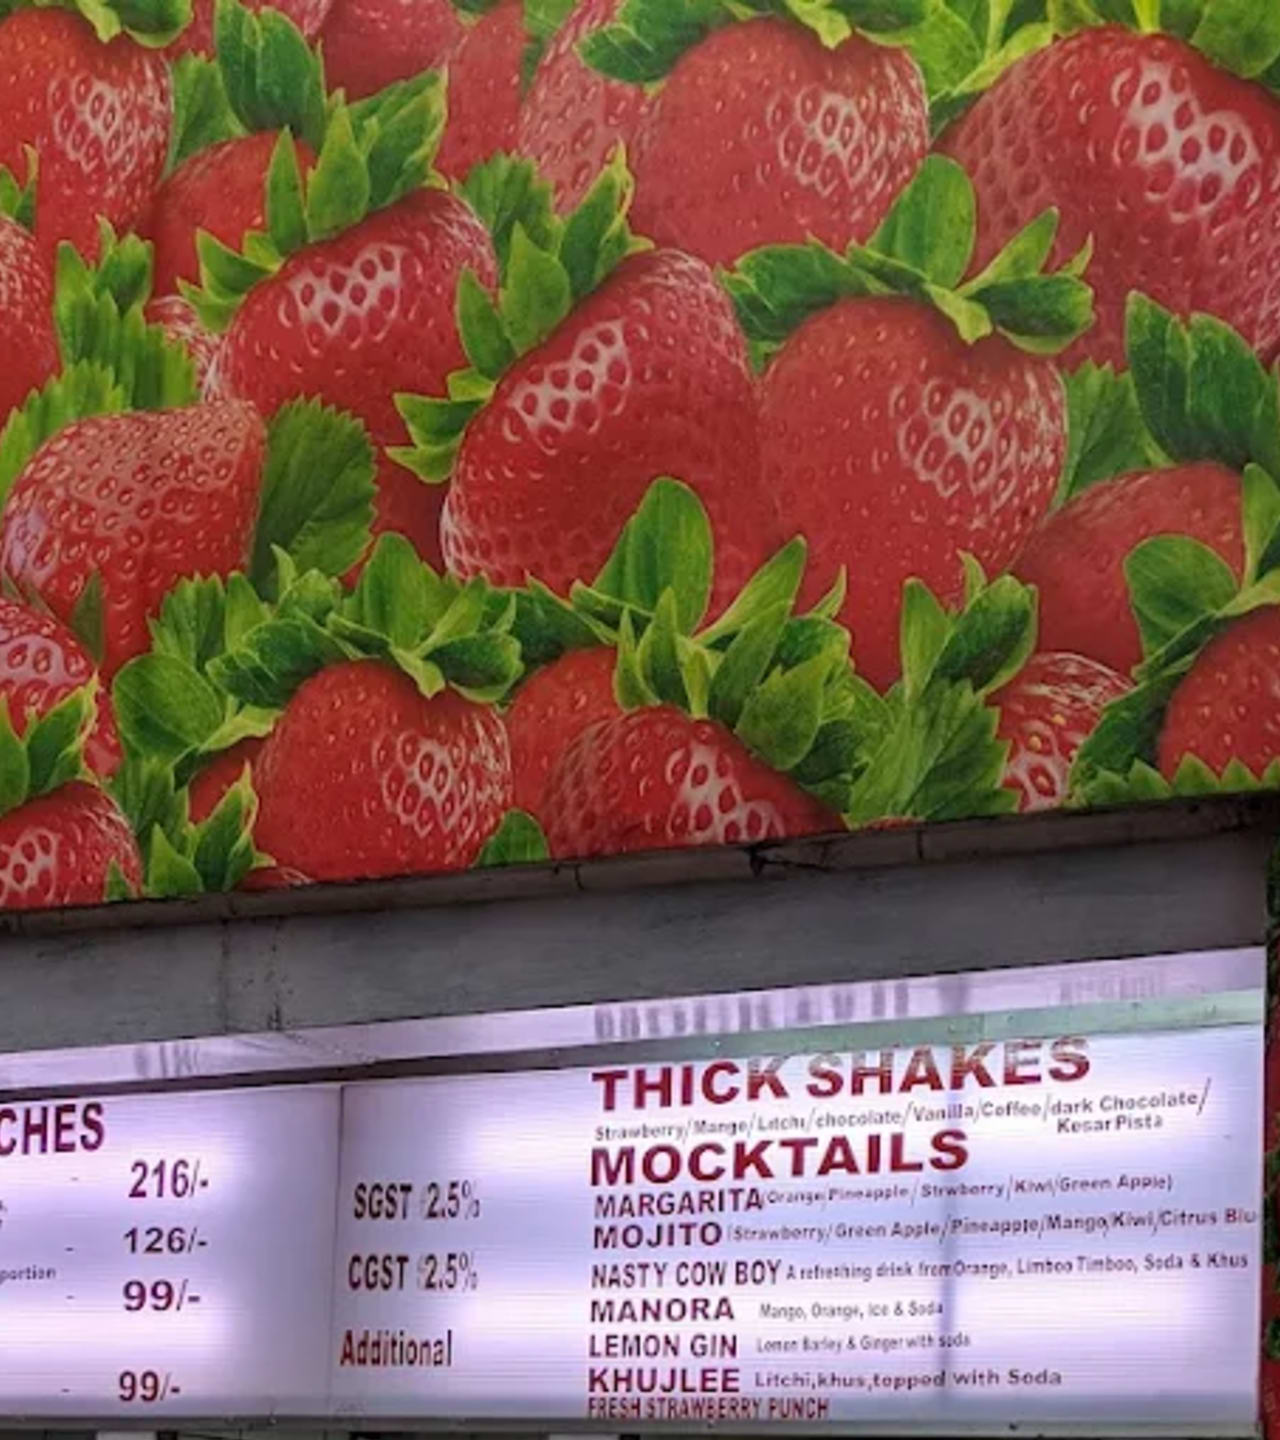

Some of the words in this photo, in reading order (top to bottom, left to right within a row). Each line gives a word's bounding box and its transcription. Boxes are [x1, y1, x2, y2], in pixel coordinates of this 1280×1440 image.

[592, 1056, 790, 1111] THICK
[807, 1037, 1090, 1098] SHAKES
[1099, 1077, 1212, 1116] Chocolate/
[590, 1129, 969, 1186] MOCKTAILS
[128, 1159, 209, 1198] 216/-
[353, 1183, 412, 1219] SGST
[424, 1180, 480, 1219] 2.5%
[594, 1188, 763, 1218] MARGARITA
[124, 1227, 208, 1254] 126/-
[594, 1222, 721, 1249] MOJITO
[348, 1254, 409, 1290] CGST
[423, 1252, 477, 1292] 2.5%
[592, 1263, 668, 1289] NASTY
[676, 1261, 726, 1287] COW
[735, 1259, 782, 1286] BOY
[122, 1279, 201, 1311] 99/-
[591, 1297, 734, 1322] MANORA
[340, 1328, 452, 1367] Additional
[590, 1335, 680, 1358] LEMON
[690, 1335, 737, 1357] GIN
[119, 1371, 180, 1401] 99/-
[588, 1368, 739, 1393] KHUJLEE
[588, 1397, 640, 1419] FRESH
[647, 1397, 761, 1419] STRAWBERRY
[770, 1396, 829, 1419] PUNCH
